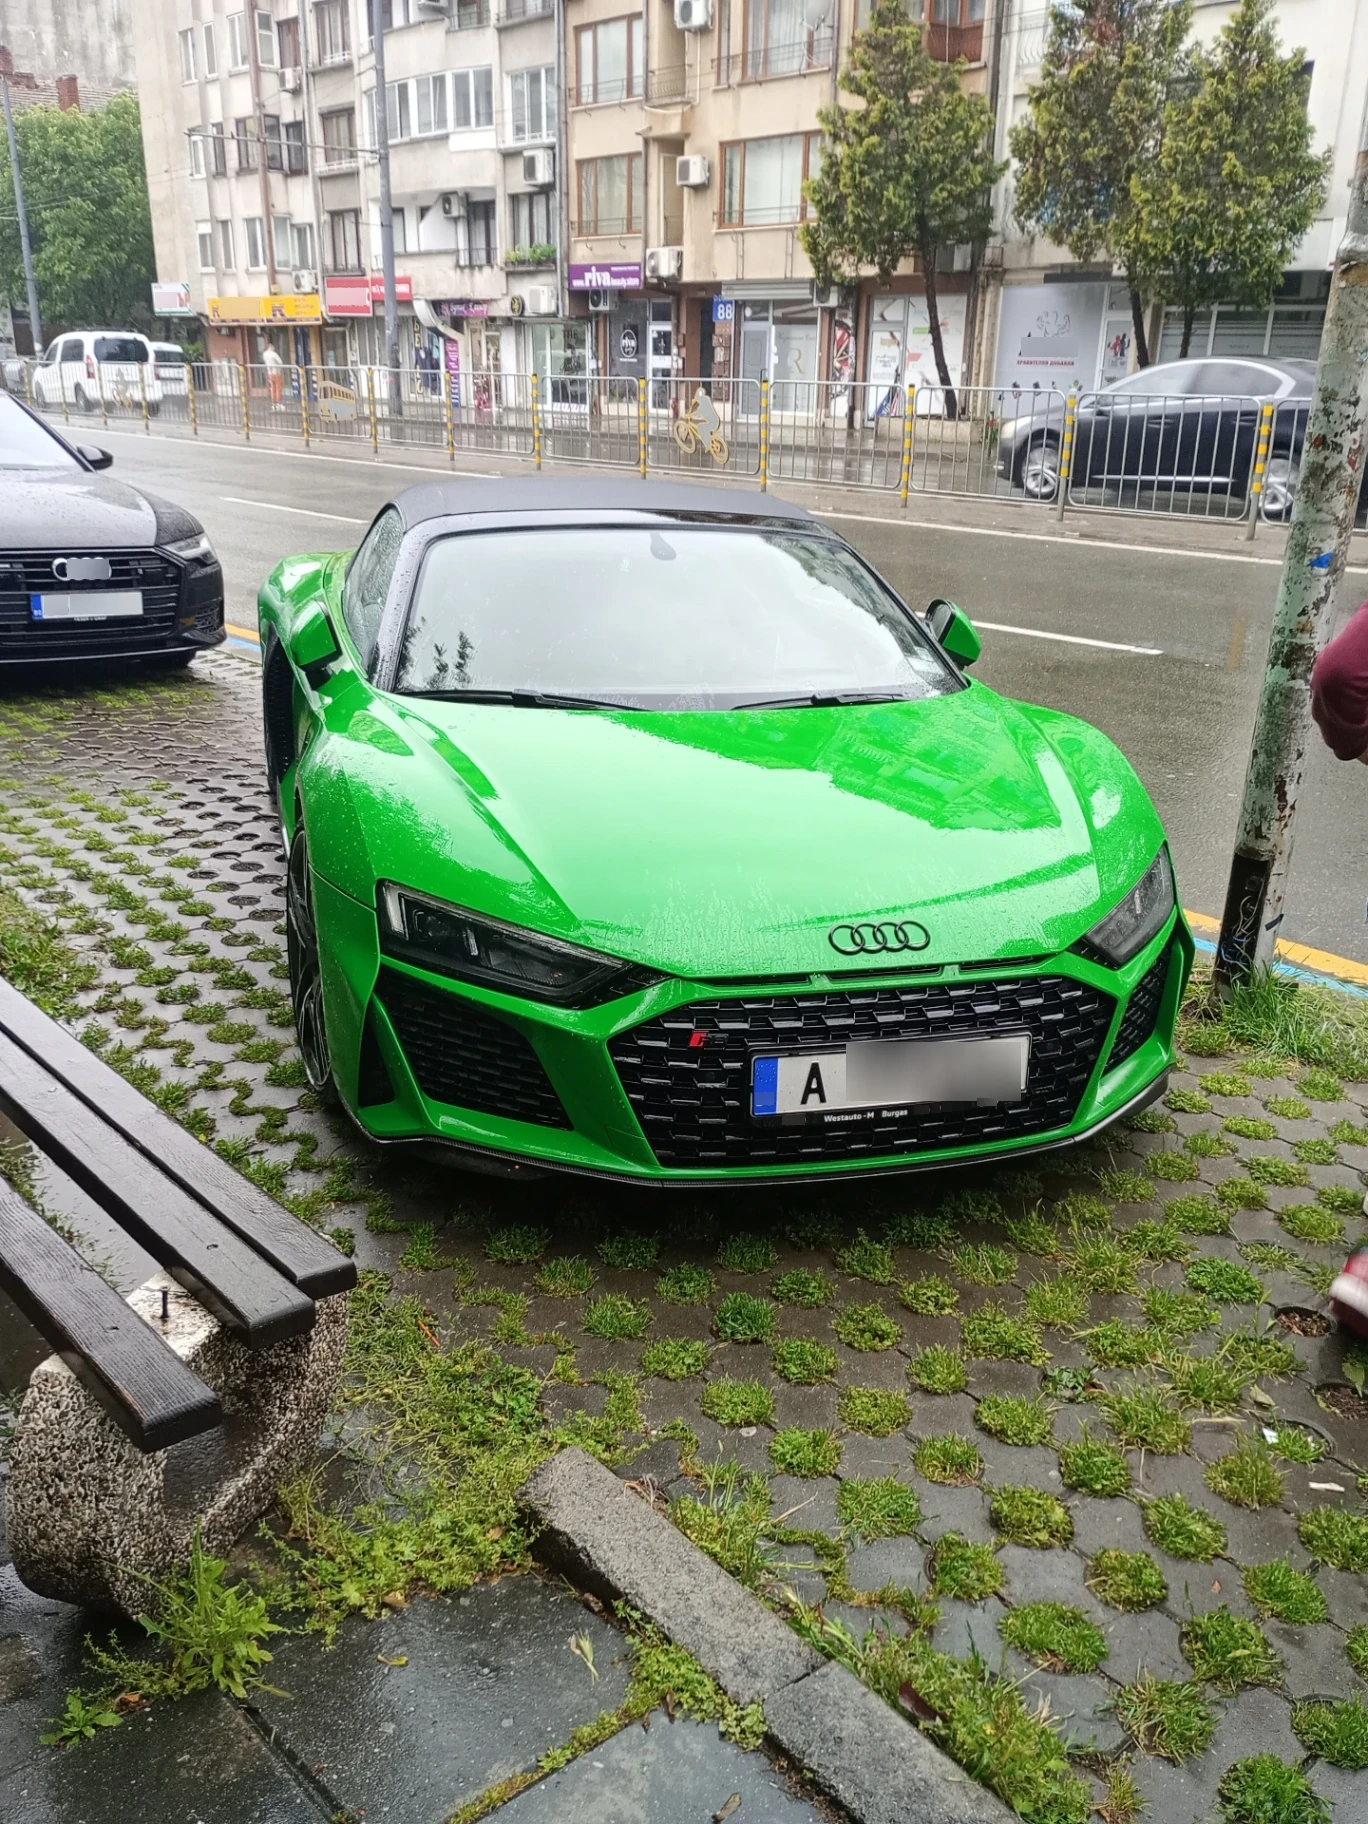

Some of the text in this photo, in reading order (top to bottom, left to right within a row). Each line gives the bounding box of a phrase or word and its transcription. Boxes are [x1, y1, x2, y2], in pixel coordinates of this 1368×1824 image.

[717, 304, 733, 320] 88
[800, 1061, 827, 1104] A
[881, 1109, 908, 1118] Burgas
